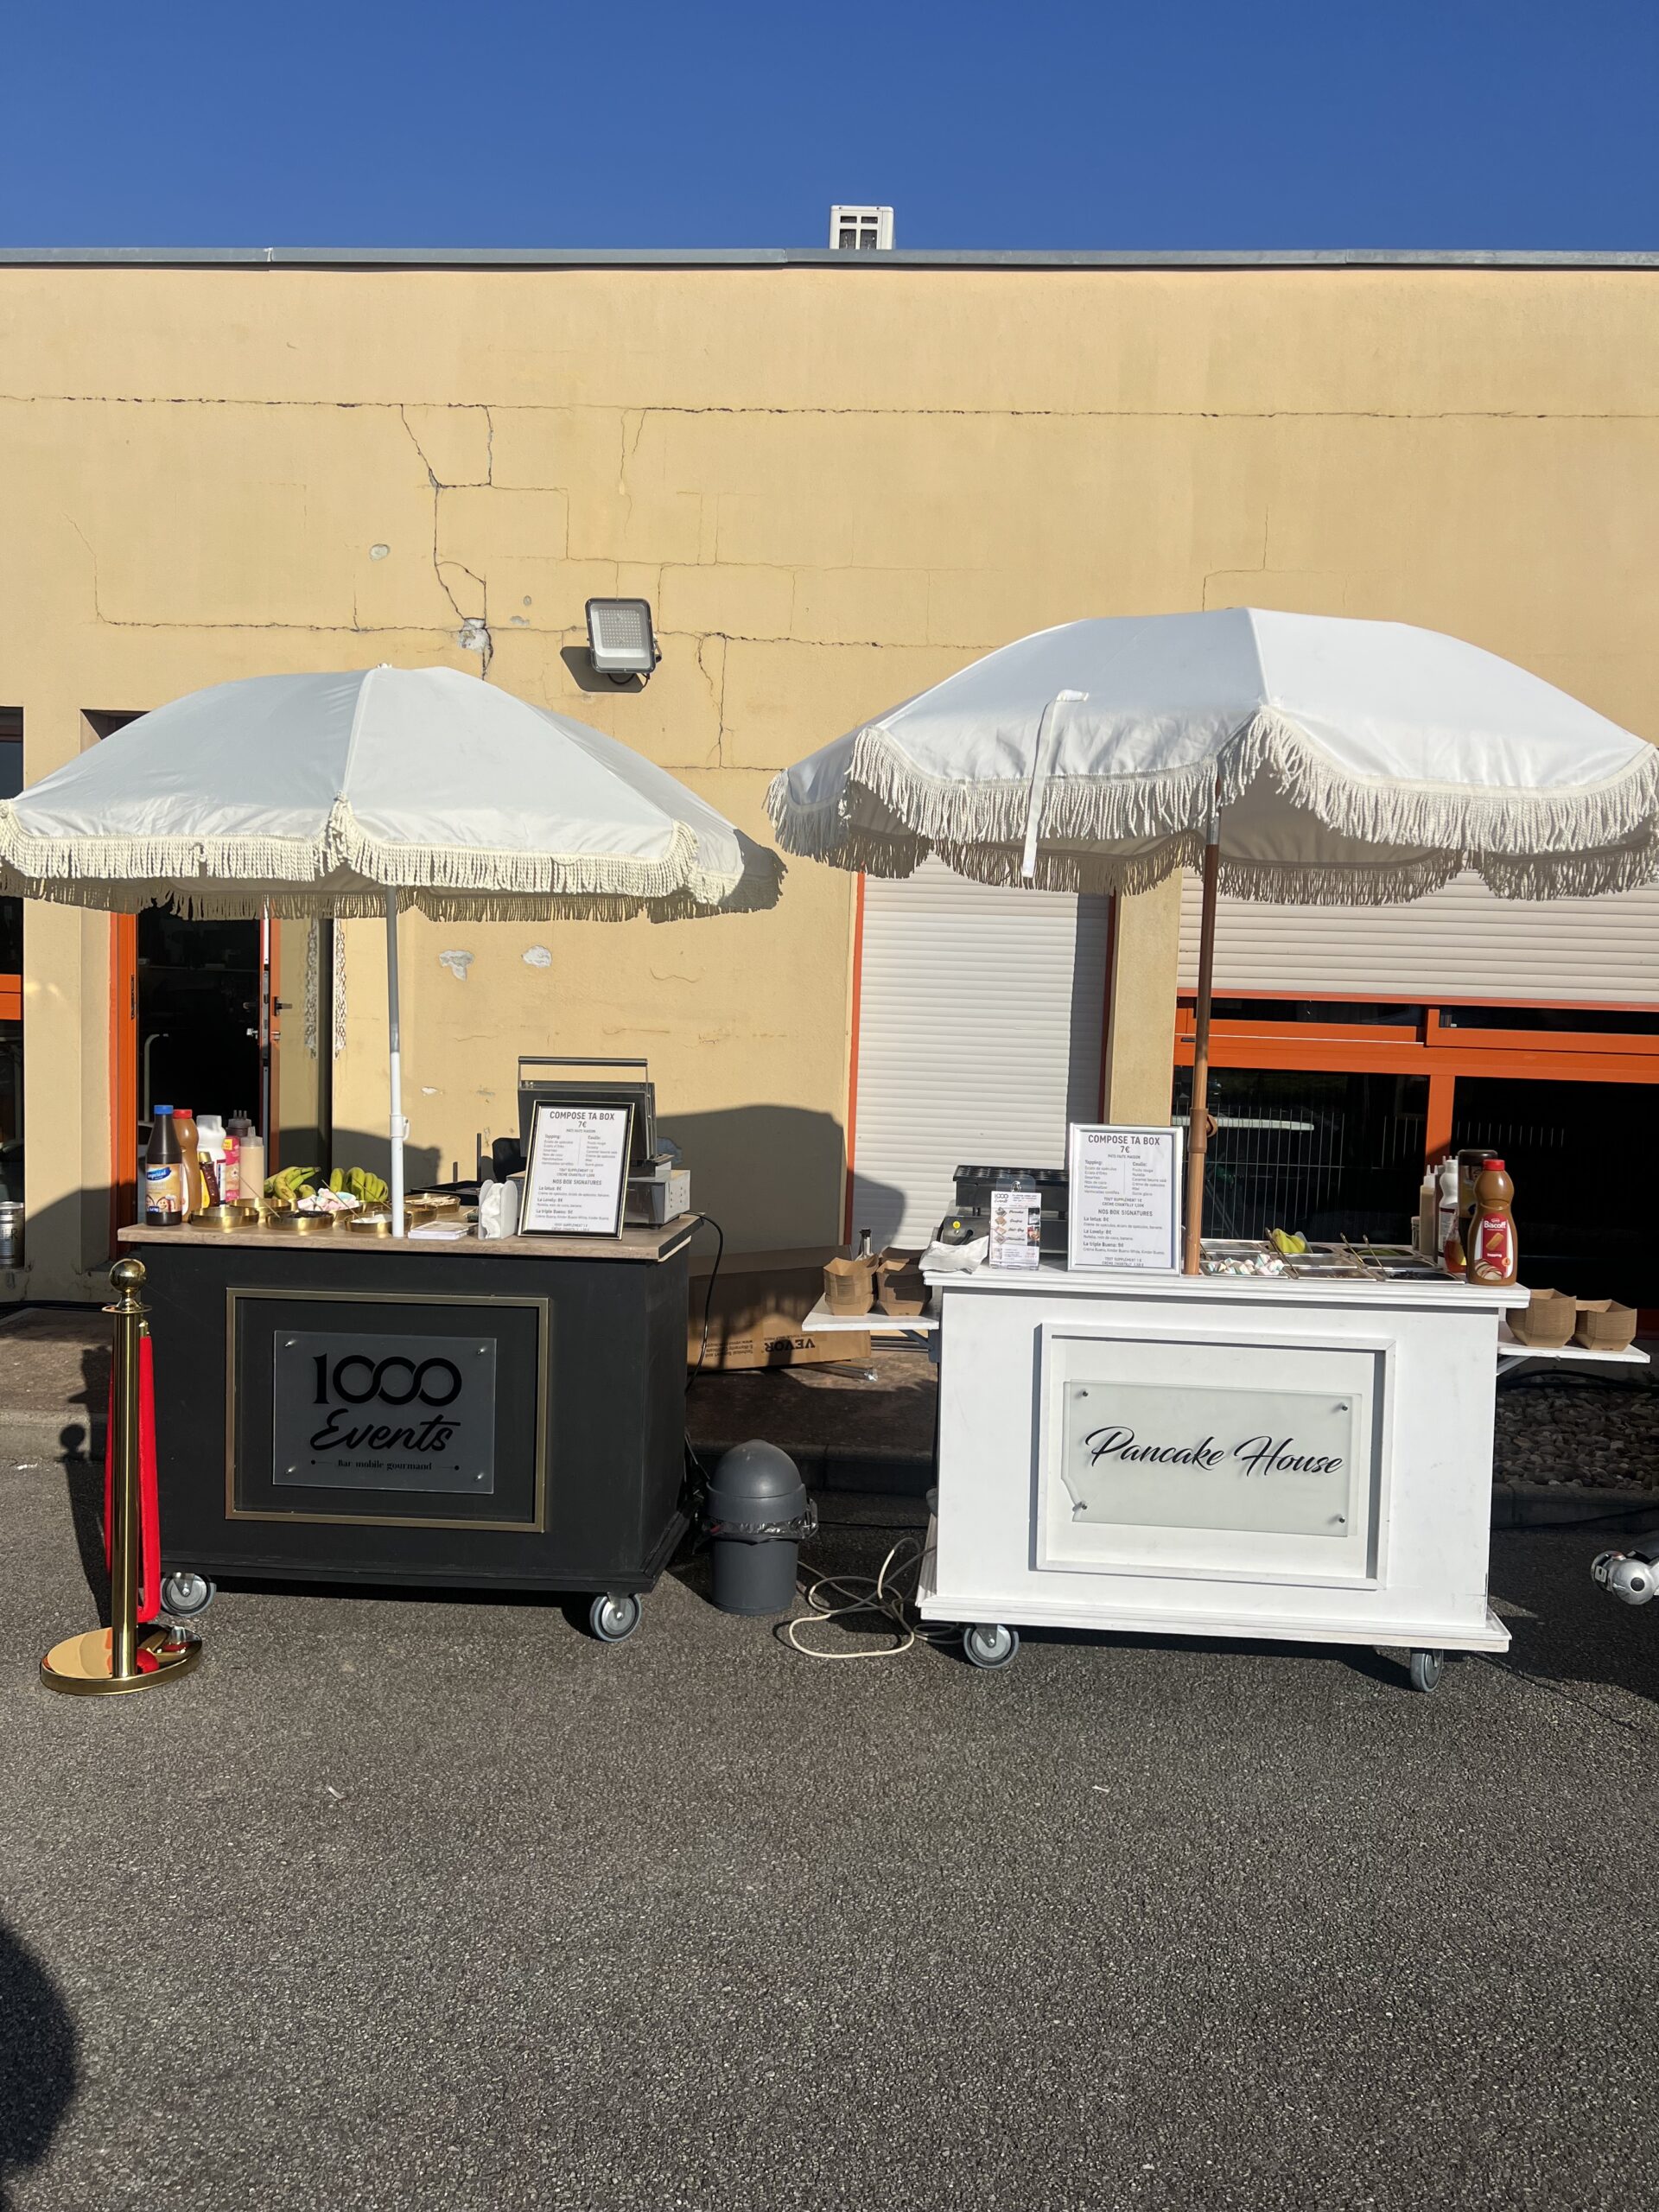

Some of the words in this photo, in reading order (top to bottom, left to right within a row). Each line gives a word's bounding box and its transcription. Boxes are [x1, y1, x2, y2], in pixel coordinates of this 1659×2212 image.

[550, 1111, 586, 1120] COMPOSE
[1089, 1135, 1128, 1144] COMPOSE
[1131, 1136, 1141, 1145] TA
[1143, 1137, 1160, 1146] BOX
[1484, 1220, 1506, 1229] Biscoff
[764, 1338, 815, 1352] VEVOR
[313, 1352, 462, 1407] 1000
[309, 1408, 461, 1452] Events
[1084, 1426, 1225, 1471] Pancake
[1234, 1435, 1344, 1477] House
[387, 1462, 432, 1471] gourmand
